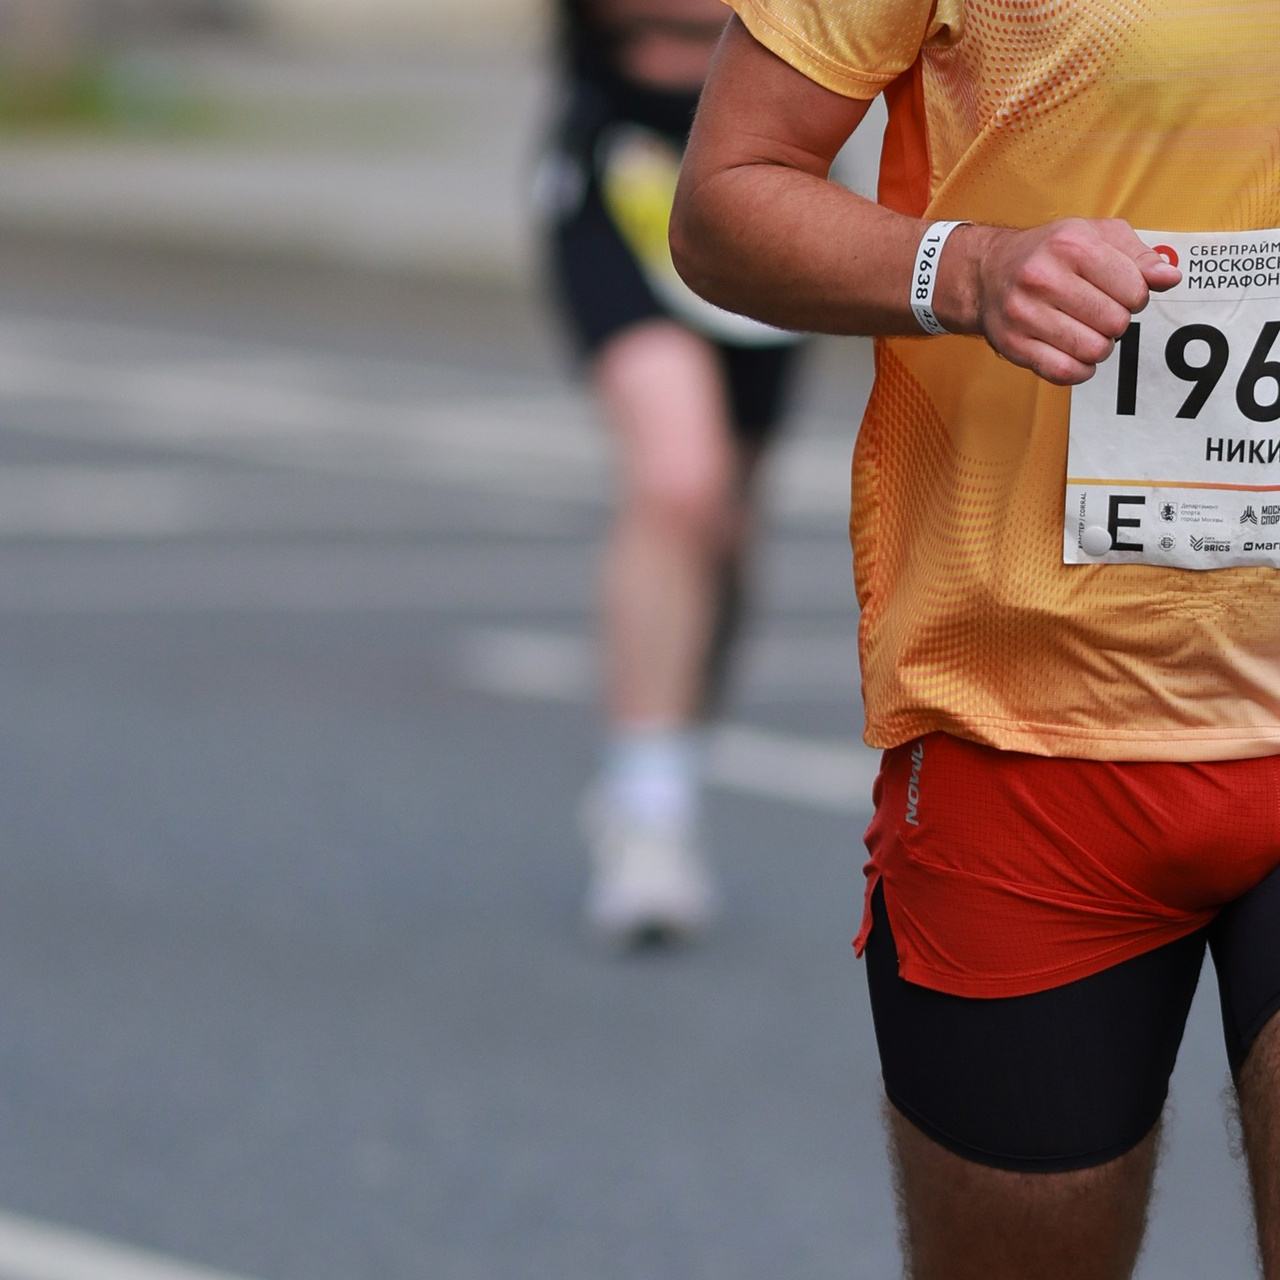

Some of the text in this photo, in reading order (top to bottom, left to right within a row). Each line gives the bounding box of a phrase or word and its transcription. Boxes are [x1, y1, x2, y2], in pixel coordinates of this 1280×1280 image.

[915, 235, 941, 300] 19638
[1187, 272, 1280, 290] МАРАФОН
[1203, 544, 1231, 552] BRICS
